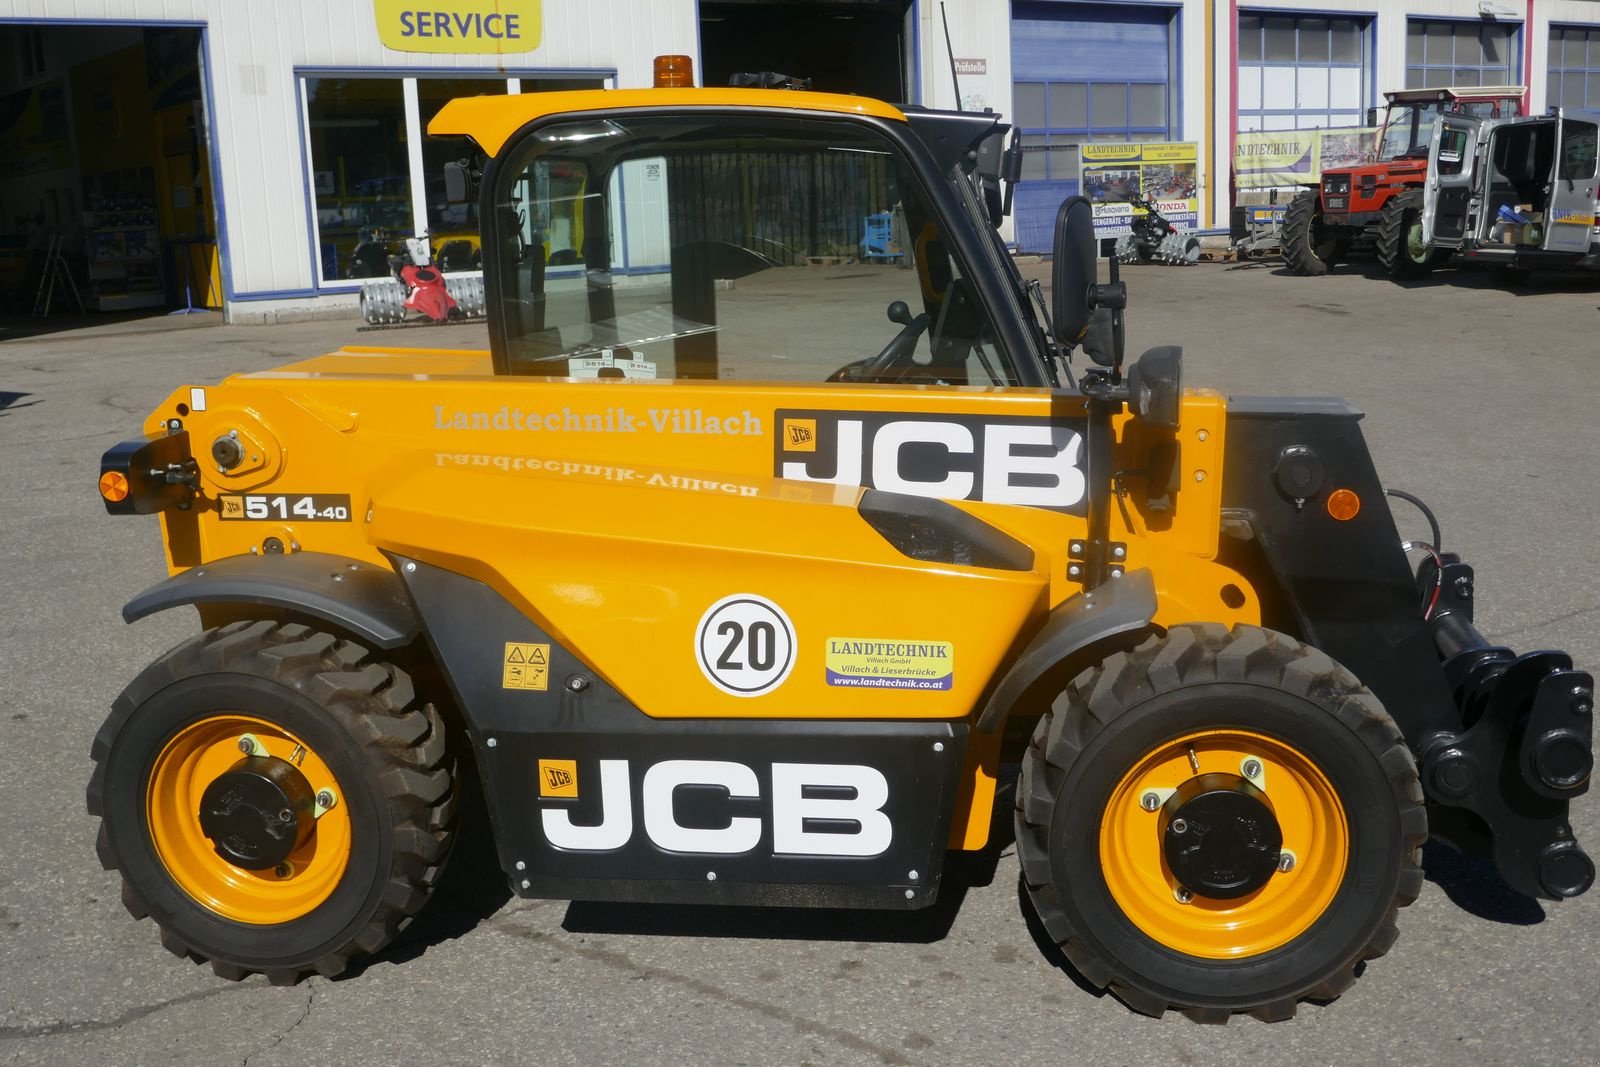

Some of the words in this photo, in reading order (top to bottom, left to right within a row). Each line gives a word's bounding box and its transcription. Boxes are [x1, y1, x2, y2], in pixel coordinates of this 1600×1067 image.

[400, 11, 521, 39] SERVICE
[1087, 145, 1136, 154] LANDTECHNIK
[1157, 203, 1187, 212] ONDA
[433, 405, 764, 435] Landtechnik-Villach
[791, 426, 812, 444] JCB
[783, 420, 1086, 507] JCB
[716, 621, 776, 671] 20
[831, 641, 948, 658] LANDTECHNIK
[841, 665, 871, 674] Villach
[880, 667, 937, 676] Lieserbrücke
[834, 678, 944, 689] www.landtechnik.co.at
[548, 767, 572, 789] JCB
[541, 760, 893, 857] JCB
